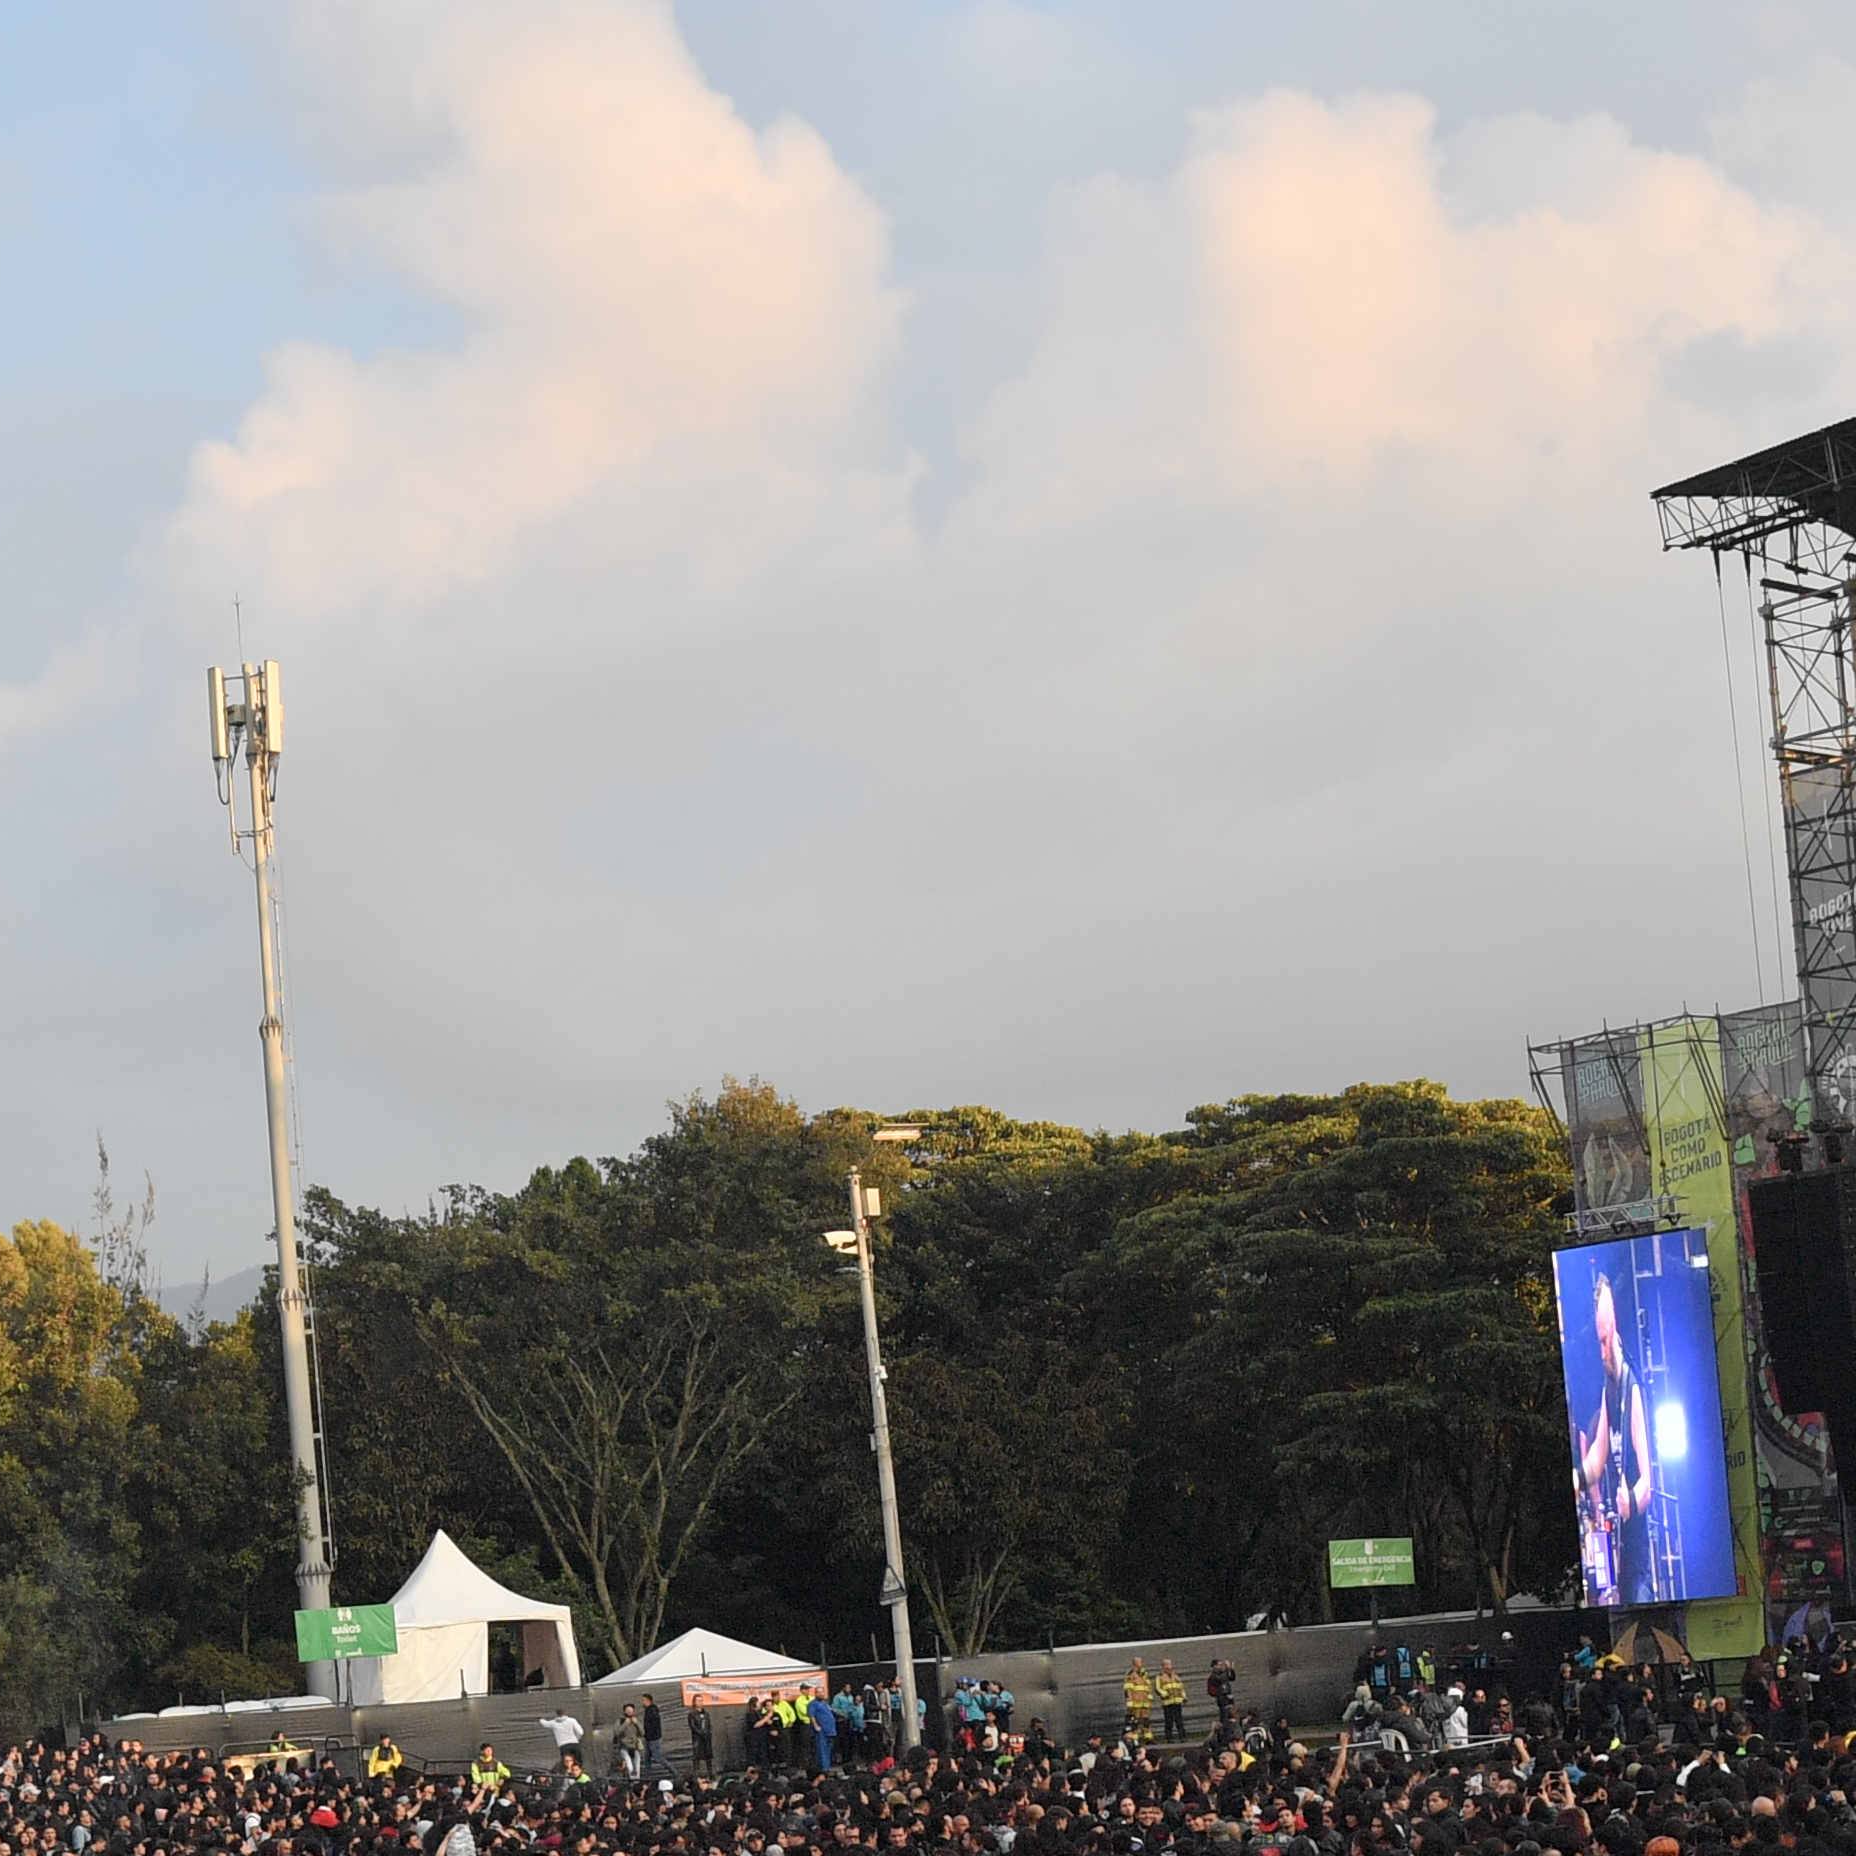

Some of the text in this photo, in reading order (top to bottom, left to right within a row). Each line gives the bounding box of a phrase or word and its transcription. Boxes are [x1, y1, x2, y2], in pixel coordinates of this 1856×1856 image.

[1670, 1137, 1707, 1163] COMO
[1658, 1150, 1723, 1187] ESCENARIO
[330, 1622, 362, 1636] BAÑOS
[335, 1634, 358, 1644] Toilet
